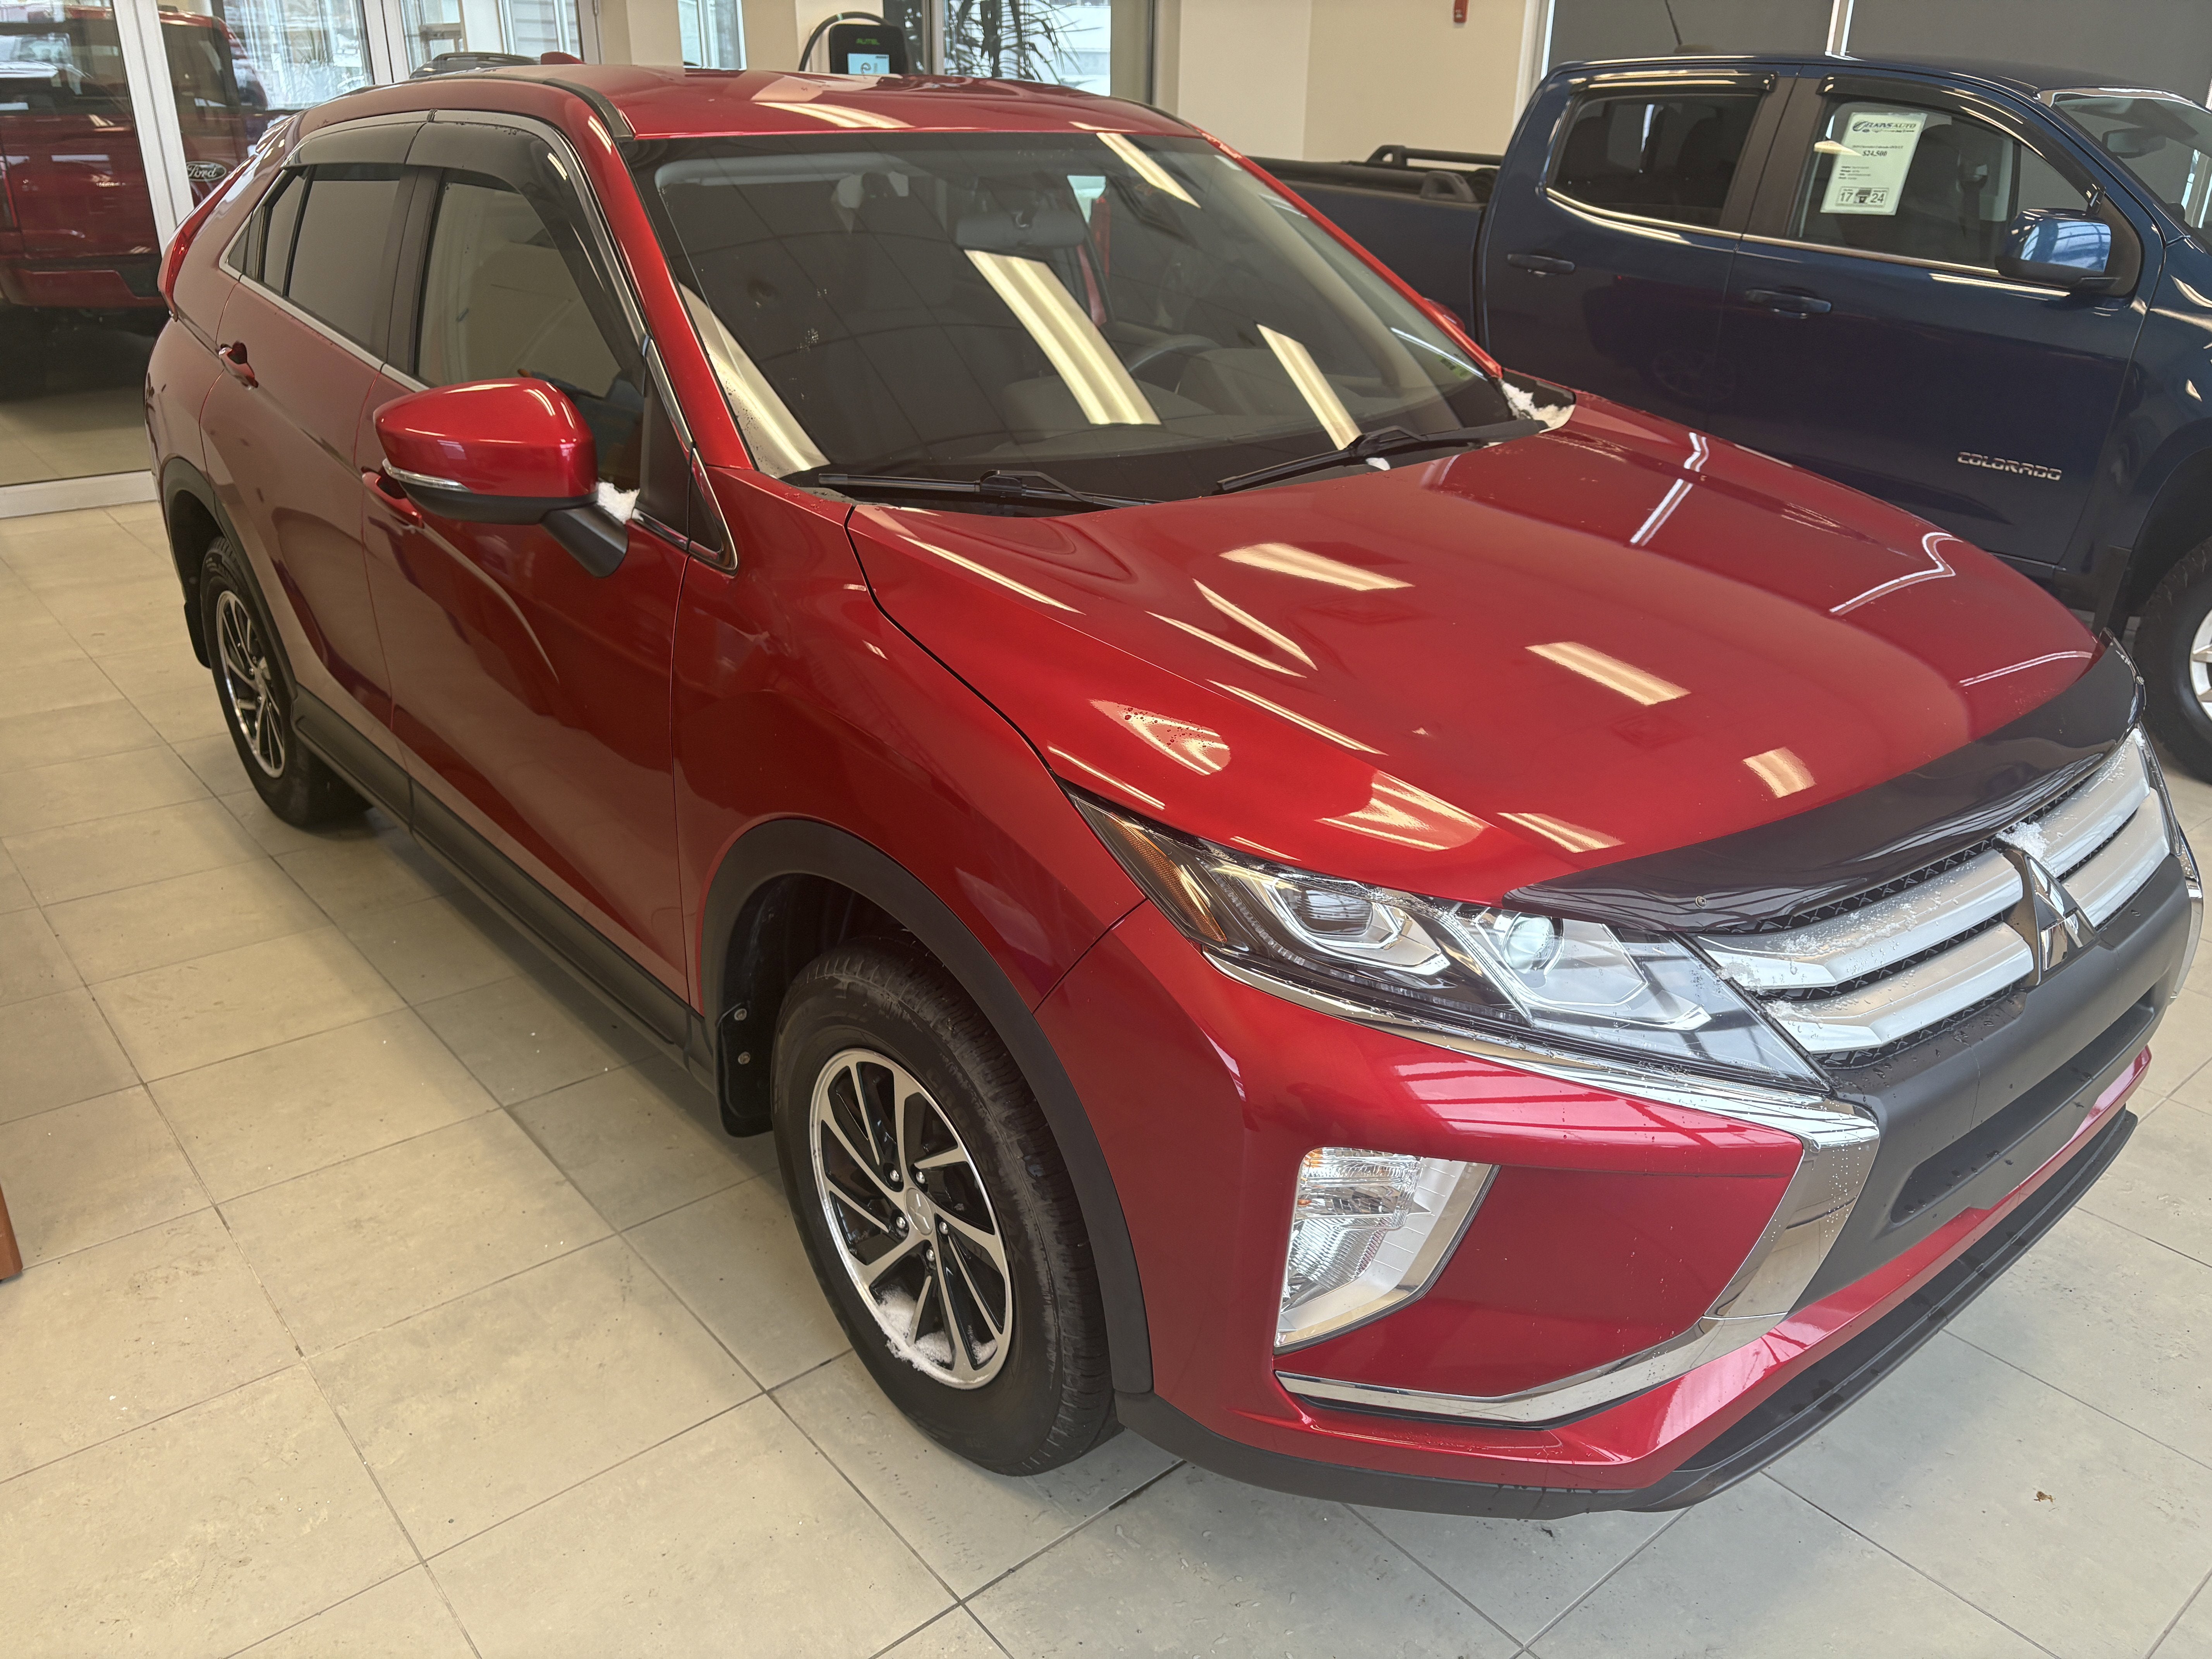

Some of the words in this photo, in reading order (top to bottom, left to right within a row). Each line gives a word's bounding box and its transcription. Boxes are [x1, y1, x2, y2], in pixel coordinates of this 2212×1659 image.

[187, 163, 217, 178] Ford
[1841, 192, 1854, 202] 17
[1870, 192, 1885, 203] 24
[1958, 451, 2062, 481] COLORADO
